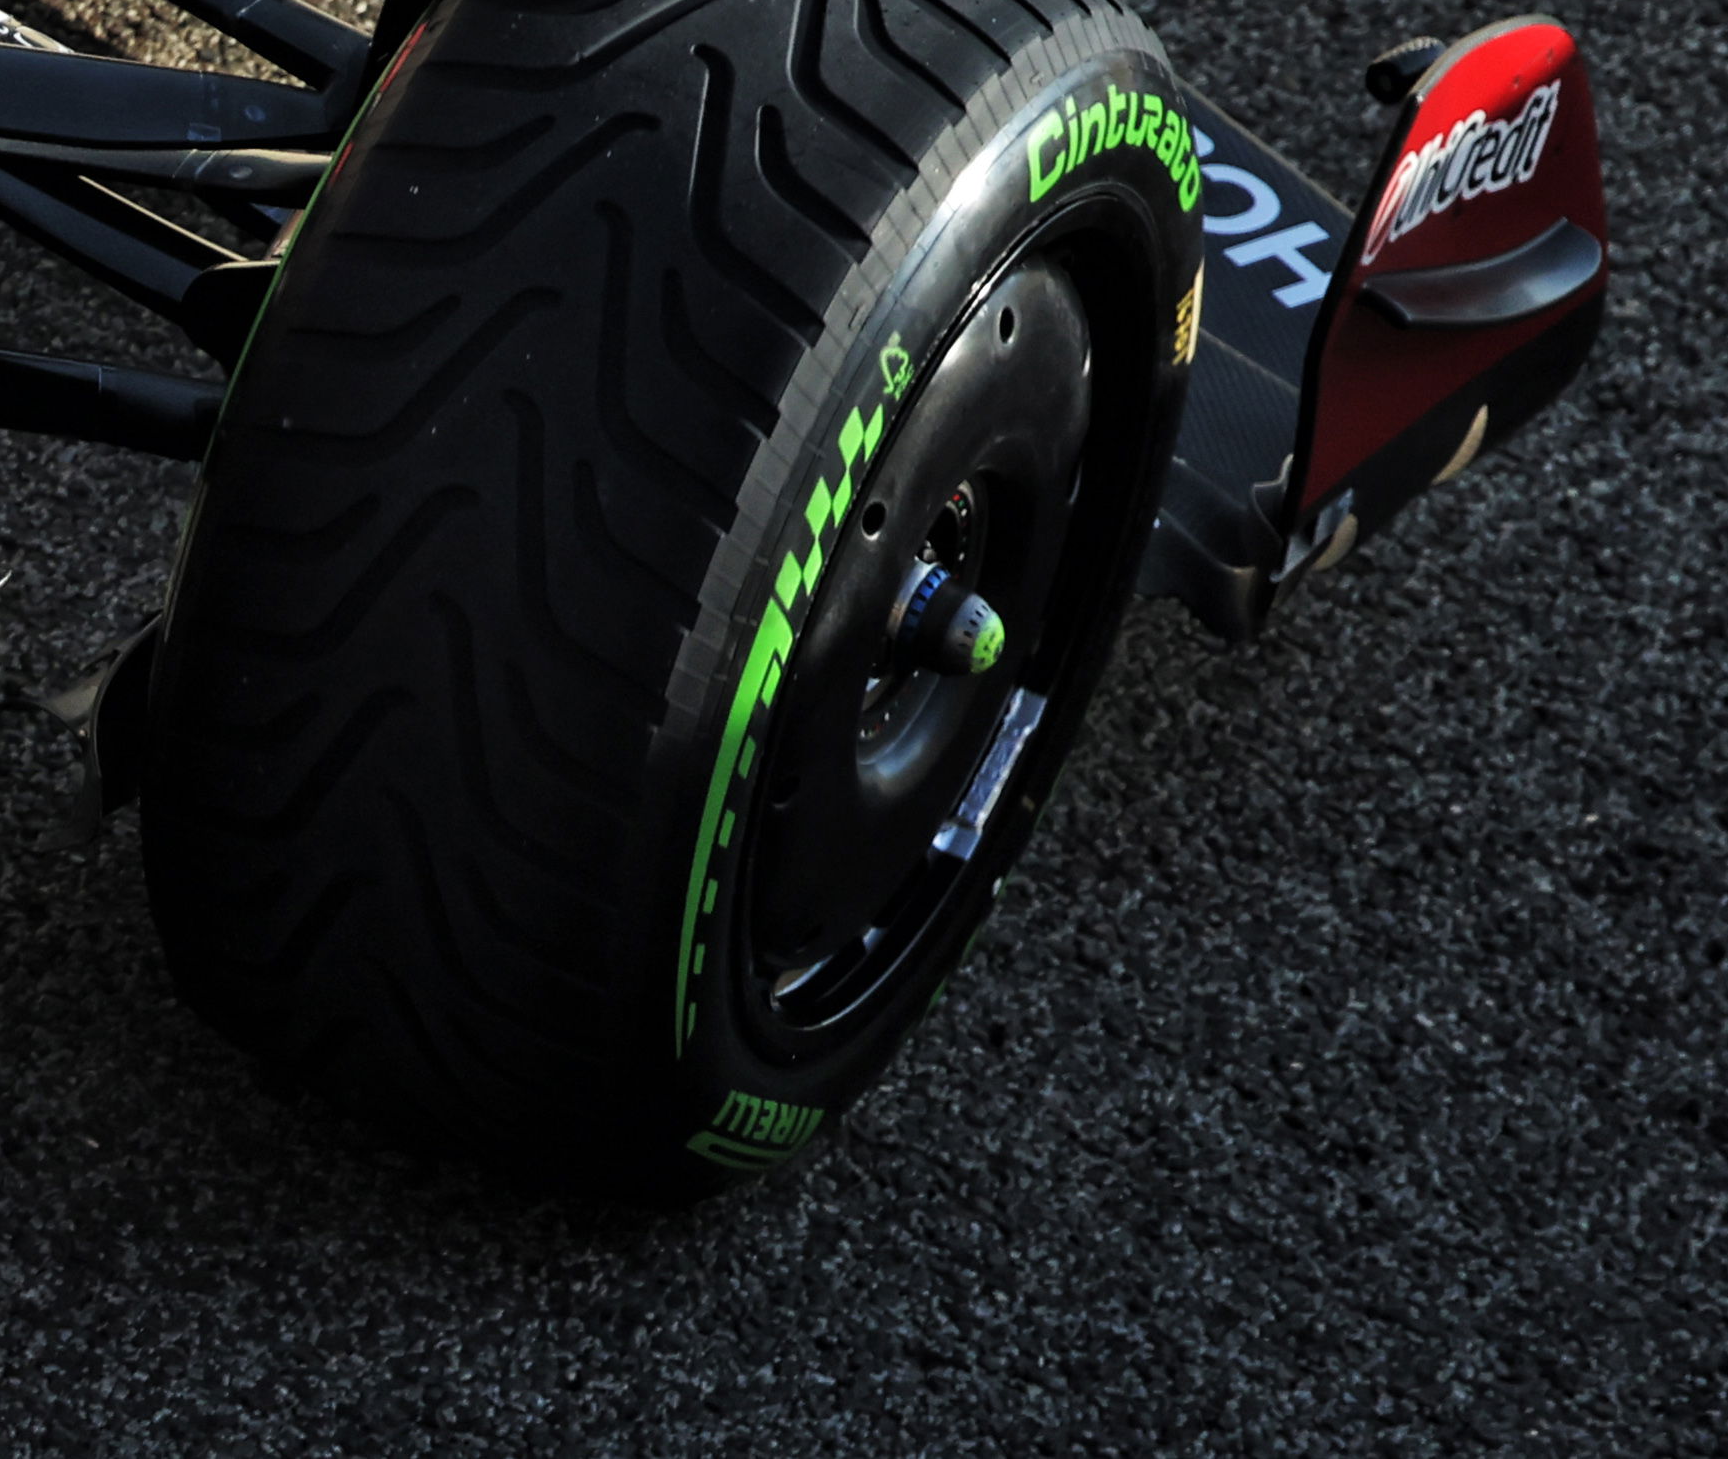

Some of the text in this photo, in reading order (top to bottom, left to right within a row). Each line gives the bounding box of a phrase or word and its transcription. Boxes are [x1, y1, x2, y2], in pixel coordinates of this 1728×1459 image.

[1027, 84, 1200, 213] Cinturato
[1379, 80, 1562, 250] UniCredit
[686, 1089, 826, 1171] PIRELLI
